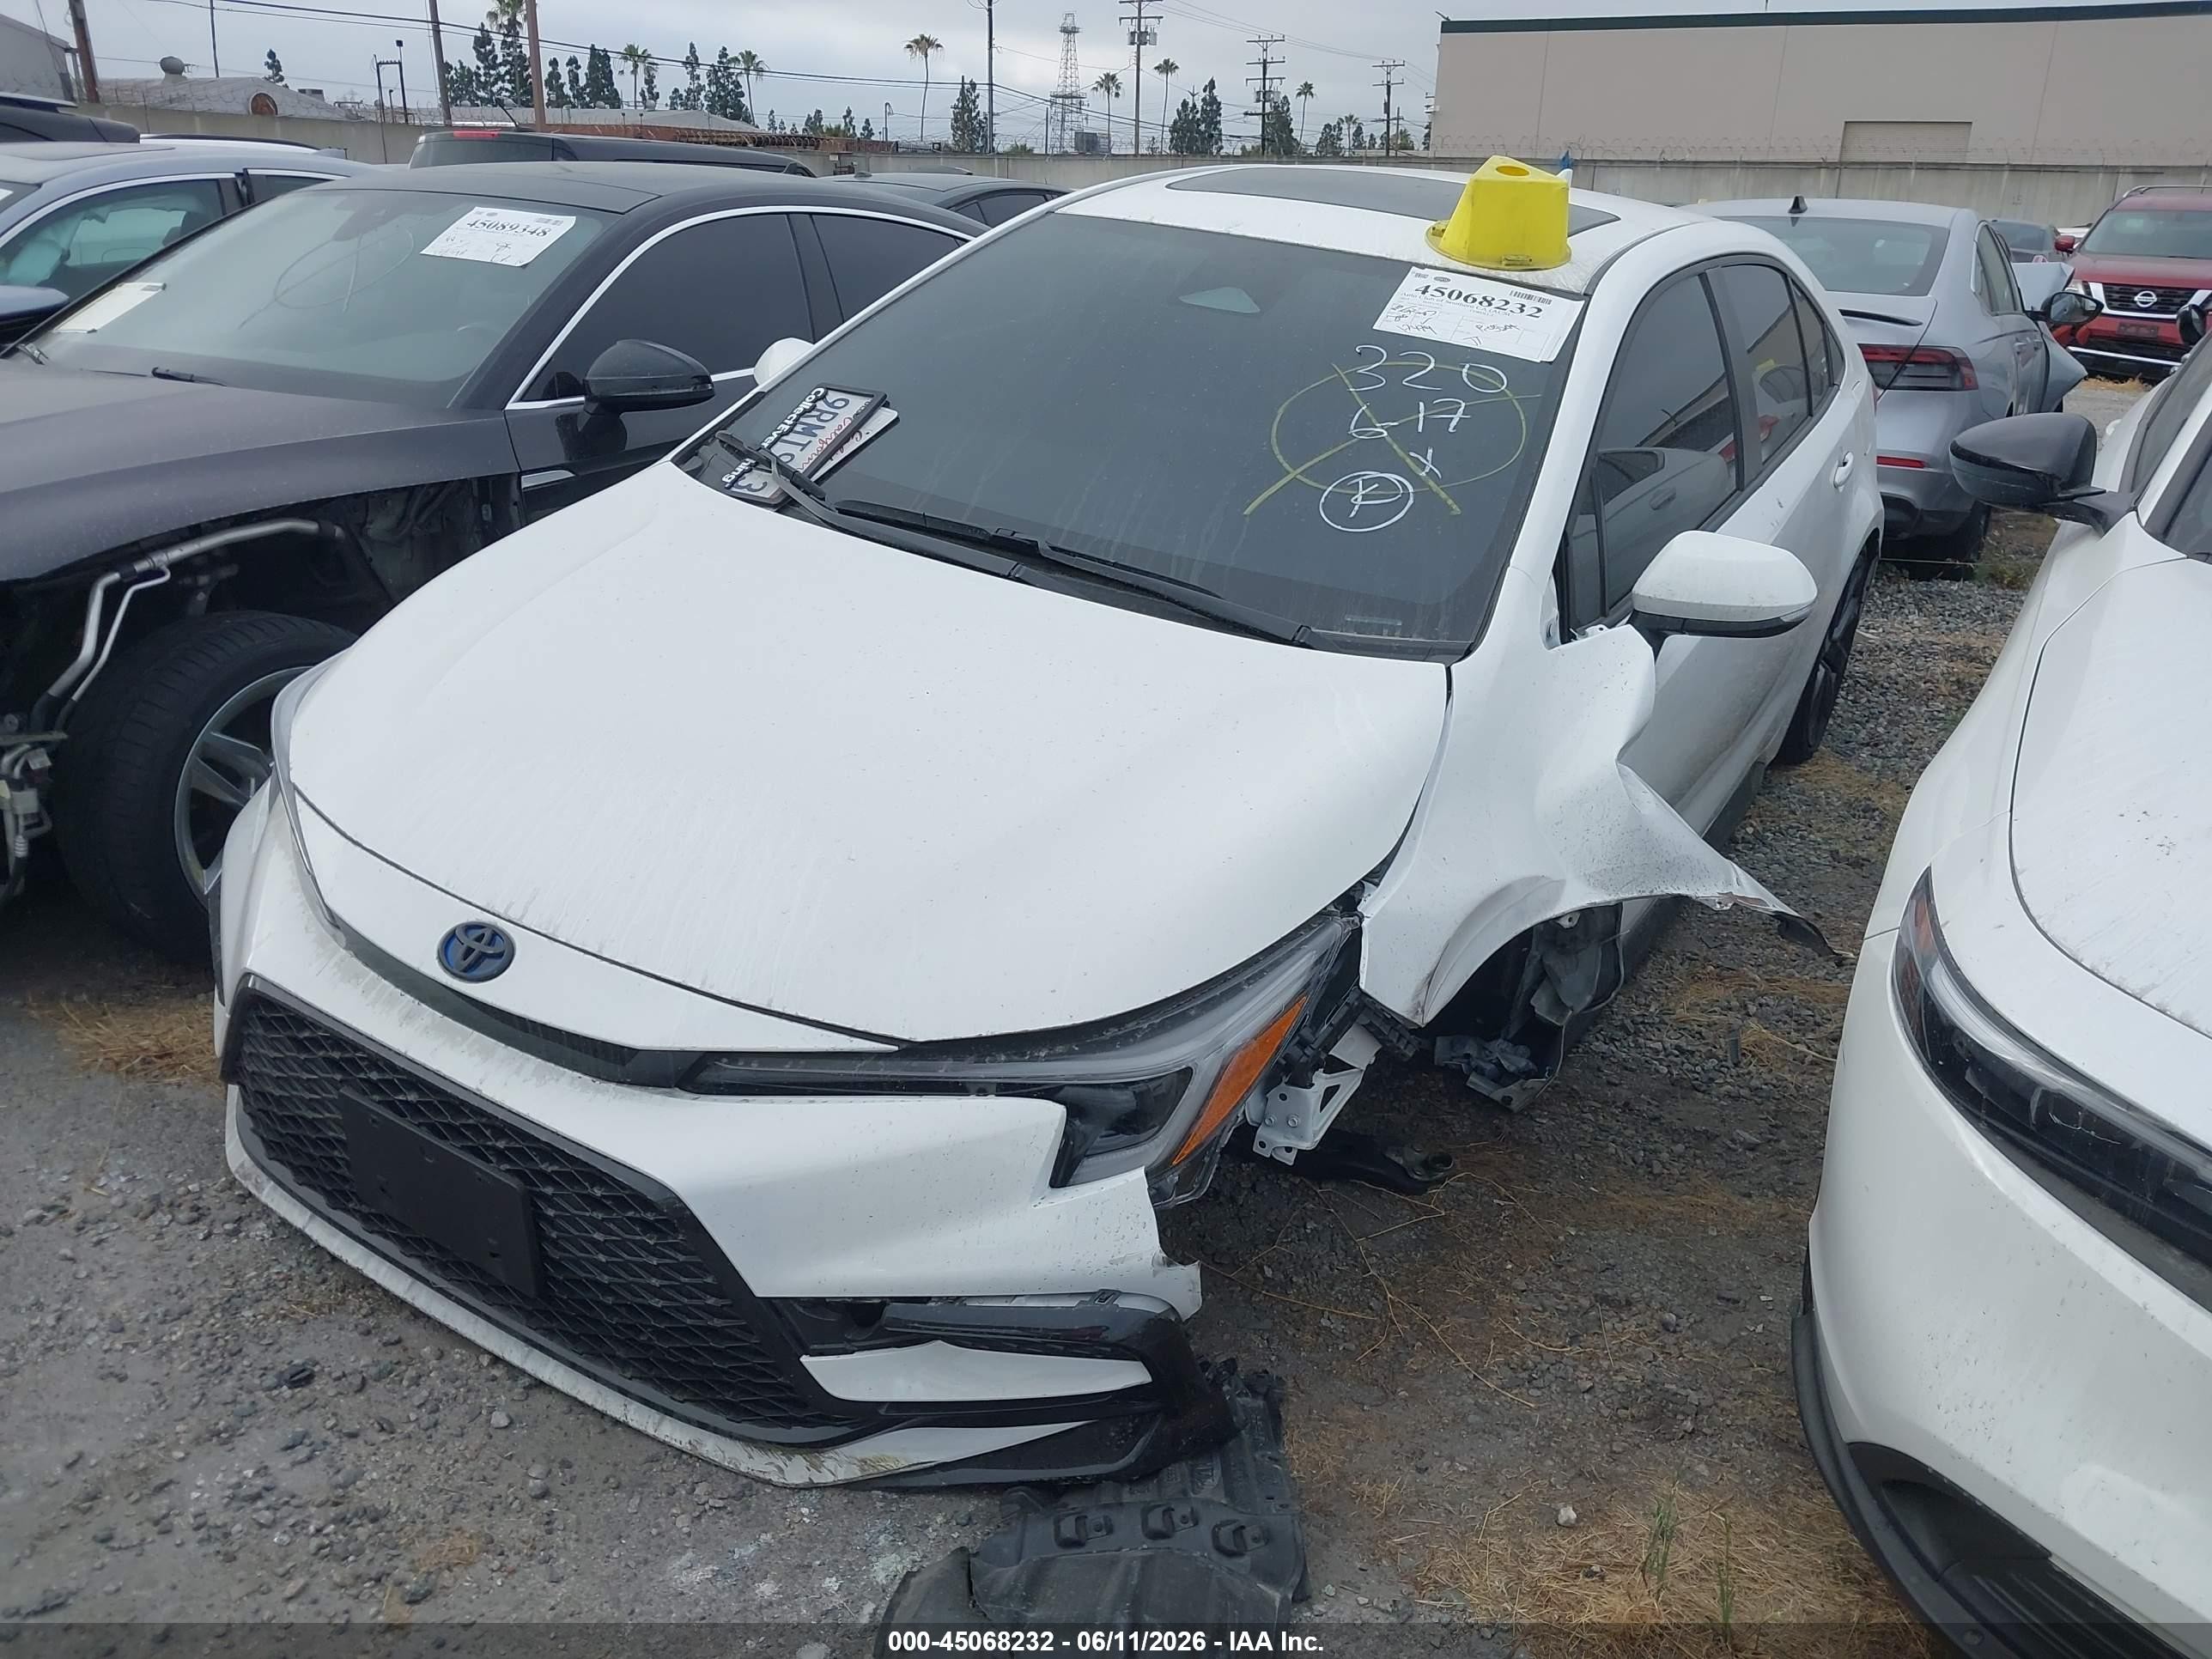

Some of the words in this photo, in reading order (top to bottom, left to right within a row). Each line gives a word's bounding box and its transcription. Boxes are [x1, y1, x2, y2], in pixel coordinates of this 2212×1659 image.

[466, 218, 551, 237] 45089348
[1415, 284, 1543, 319] 45068232
[1346, 345, 1507, 392] 320
